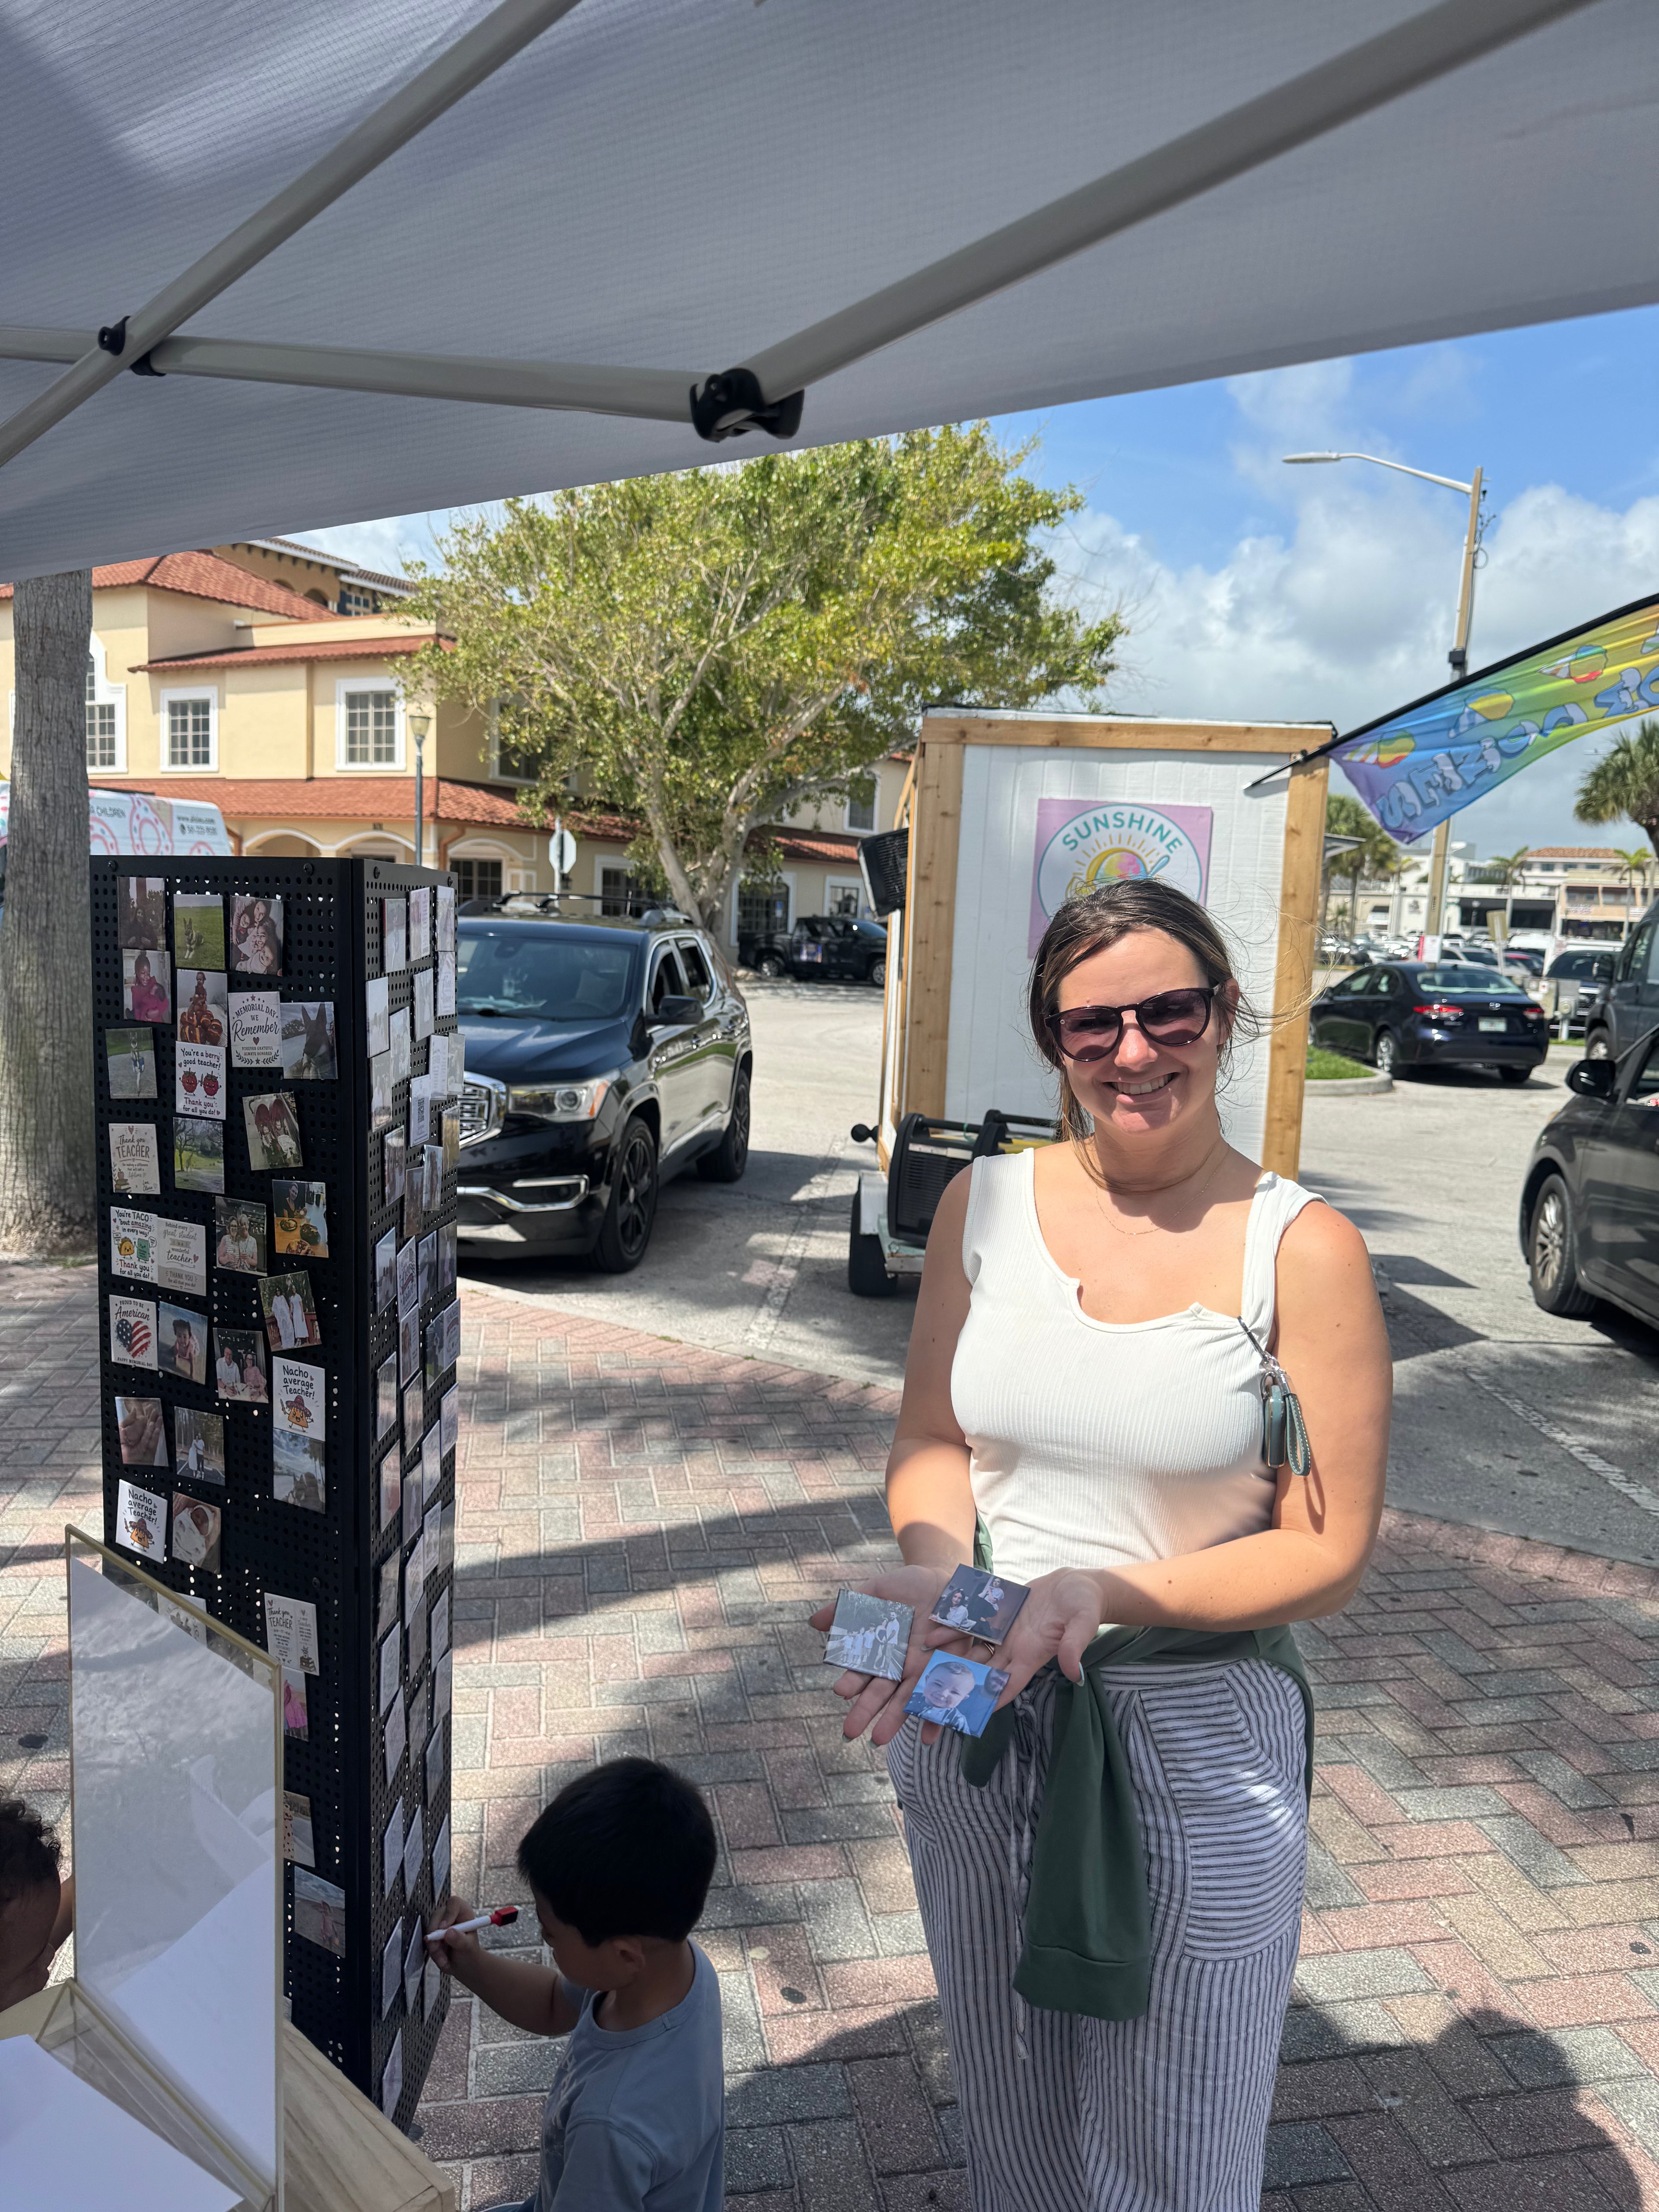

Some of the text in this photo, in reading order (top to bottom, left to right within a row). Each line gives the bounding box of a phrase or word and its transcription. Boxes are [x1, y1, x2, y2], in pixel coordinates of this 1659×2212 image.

[1062, 812, 1182, 854] SUNSHINE
[235, 1004, 276, 1018] MEMORIAL DAY
[232, 1017, 279, 1042] Remember
[181, 1048, 199, 1056] You're
[205, 1050, 220, 1062] berry
[183, 1058, 221, 1070] good teacher!
[184, 1097, 202, 1106] Thank
[118, 1135, 135, 1145] Thank
[116, 1145, 149, 1158] TEACHER
[116, 1210, 149, 1222] You're TACO
[131, 1221, 152, 1232] amazing
[163, 1229, 197, 1241] great student
[166, 1249, 193, 1264] teacher.
[119, 1259, 138, 1269] Thank
[170, 1271, 184, 1279] THANK
[114, 1306, 150, 1321] American
[283, 1365, 308, 1378] Nacho
[283, 1377, 314, 1390] average
[283, 1385, 315, 1400] Teacher!
[129, 1489, 152, 1504] Nacho
[128, 1500, 156, 1516] average
[128, 1507, 157, 1525] Teacher!
[267, 1607, 281, 1616] Thank
[268, 1617, 293, 1630] TEACHER
